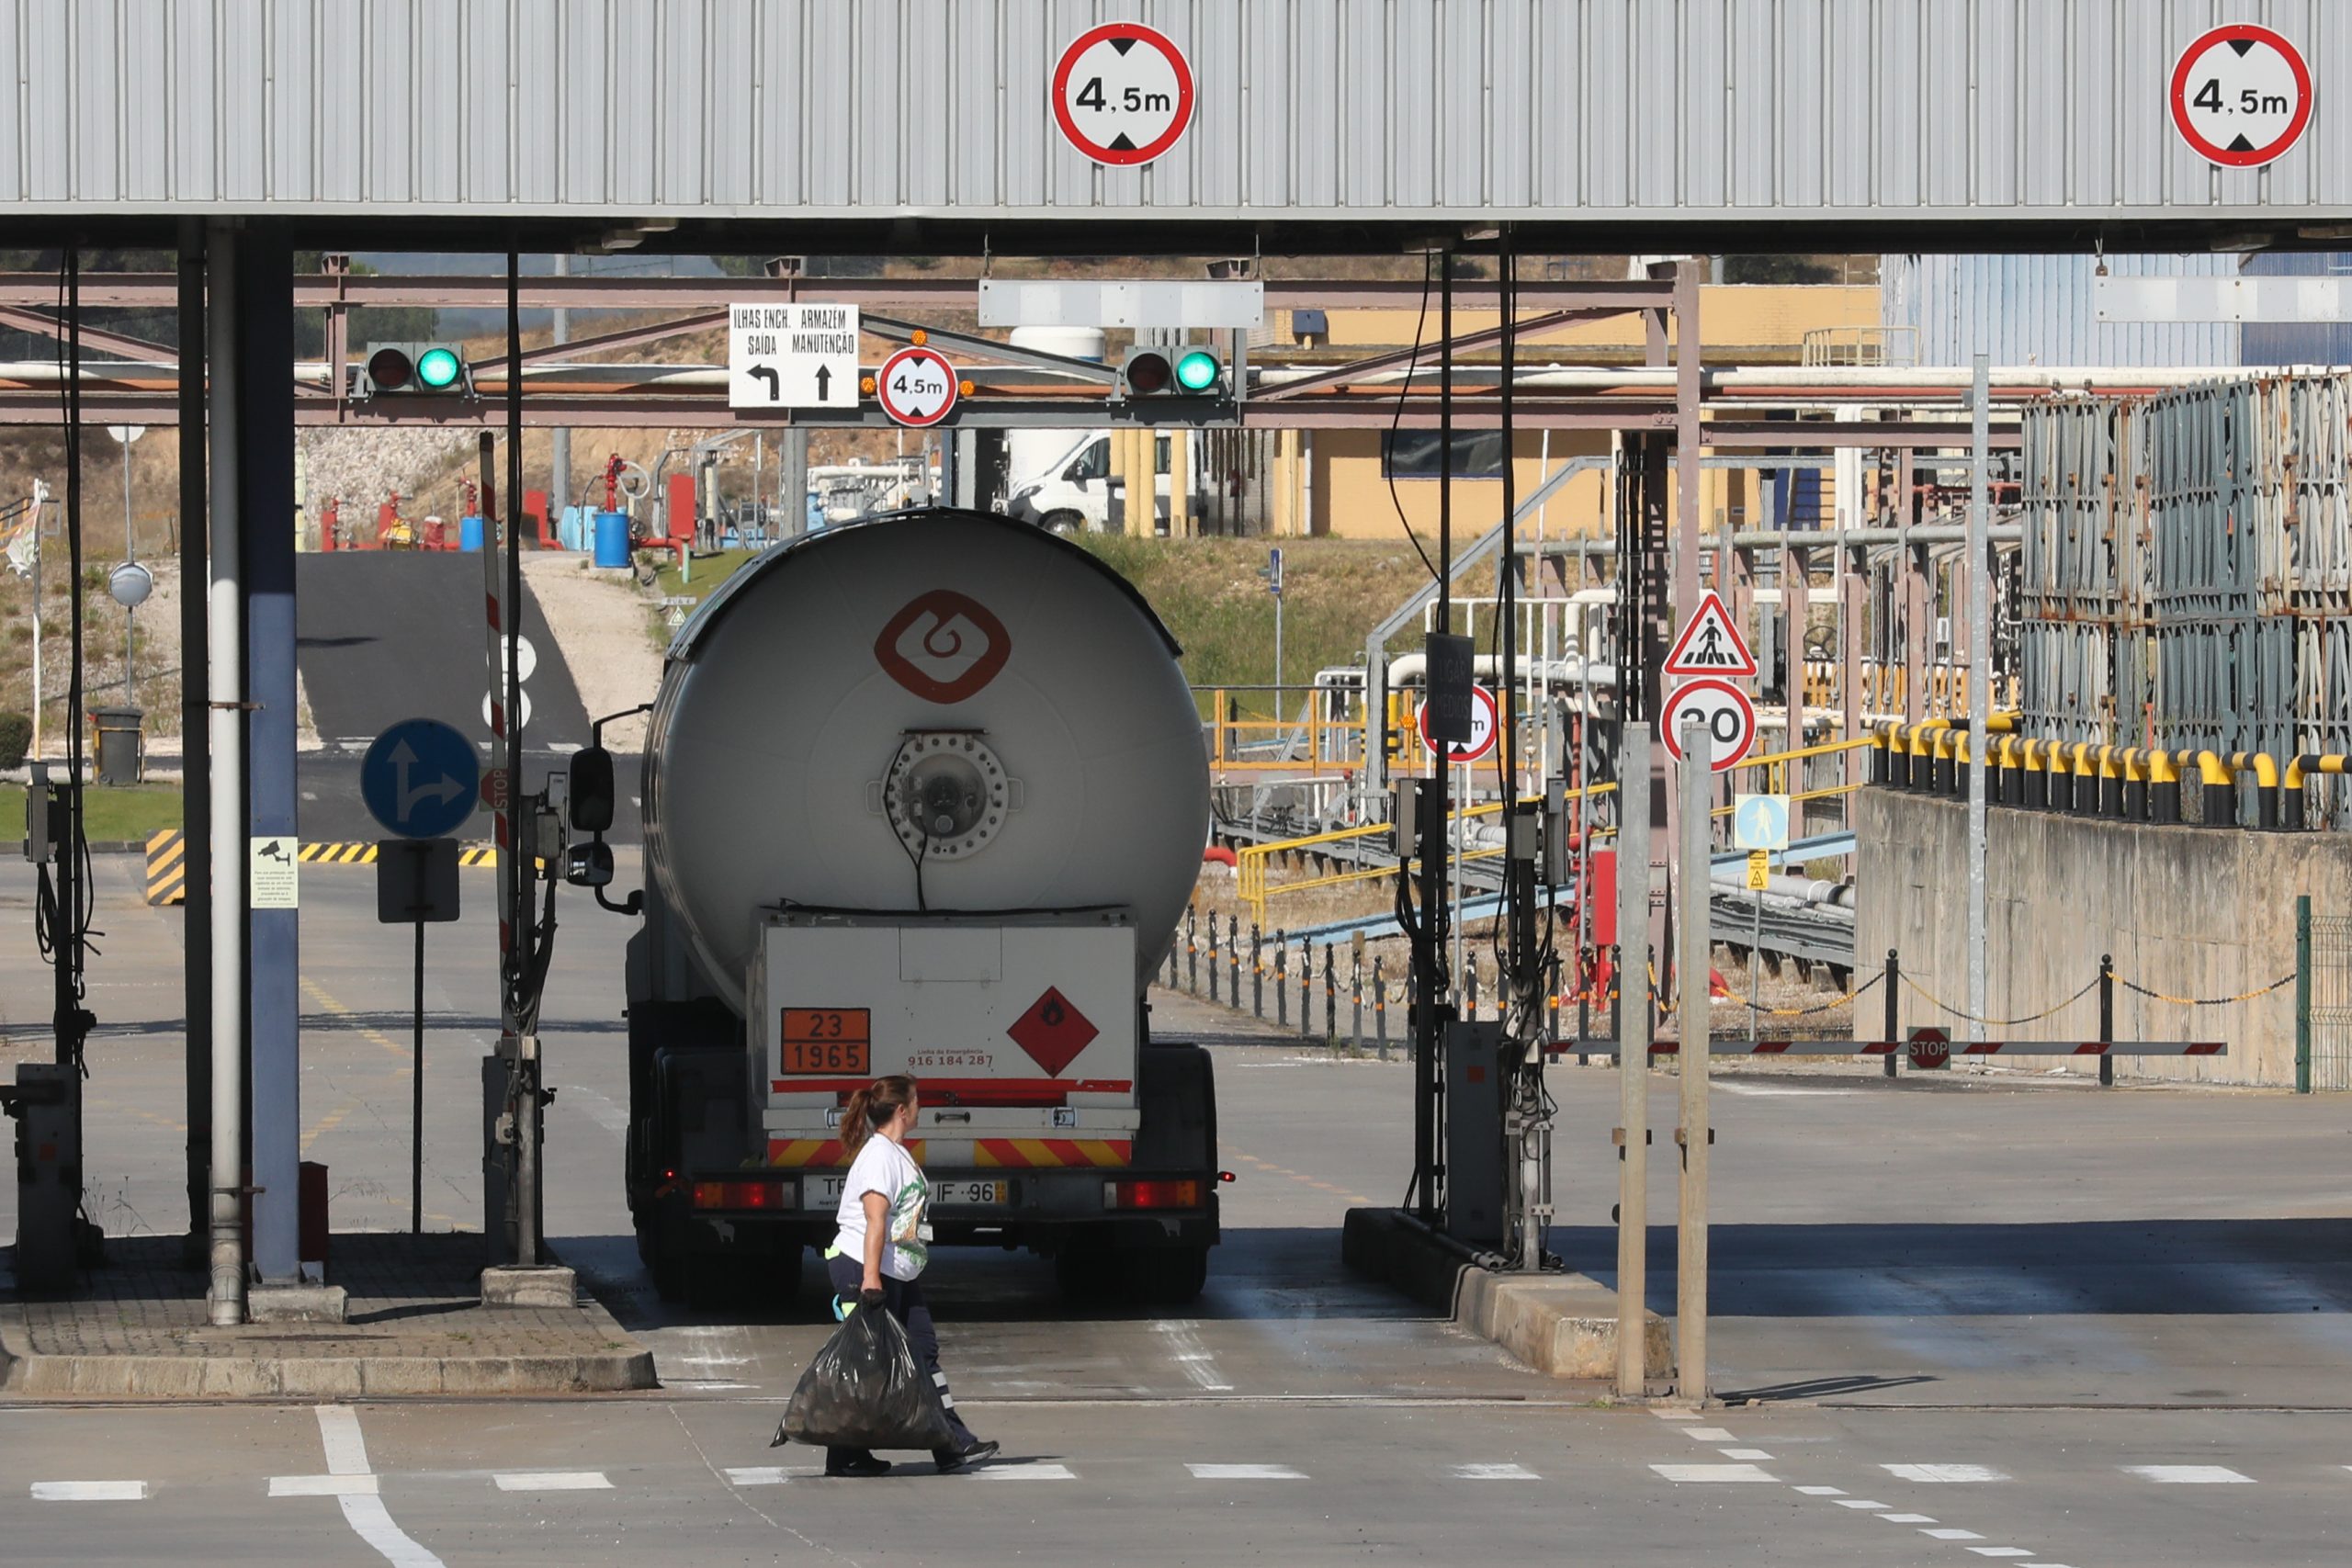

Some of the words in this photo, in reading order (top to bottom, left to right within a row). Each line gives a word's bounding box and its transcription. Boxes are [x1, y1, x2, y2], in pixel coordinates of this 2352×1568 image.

[1076, 76, 1170, 115] 4,5m
[2193, 78, 2288, 116] 4,5m
[734, 309, 761, 329] ILHAS
[764, 309, 791, 329] ENCH.
[801, 307, 846, 329] ARMAZÉM
[748, 333, 776, 355] SAÍDA
[792, 332, 854, 357] MANUTENÇÃO
[893, 375, 943, 395] 4,5m
[493, 770, 508, 808] STOP
[809, 1013, 842, 1037] 23
[795, 1044, 860, 1068] 1965
[1910, 1041, 1948, 1056] STOP
[908, 1055, 933, 1066] 916
[939, 1055, 963, 1066] 184
[968, 1055, 993, 1067] 287
